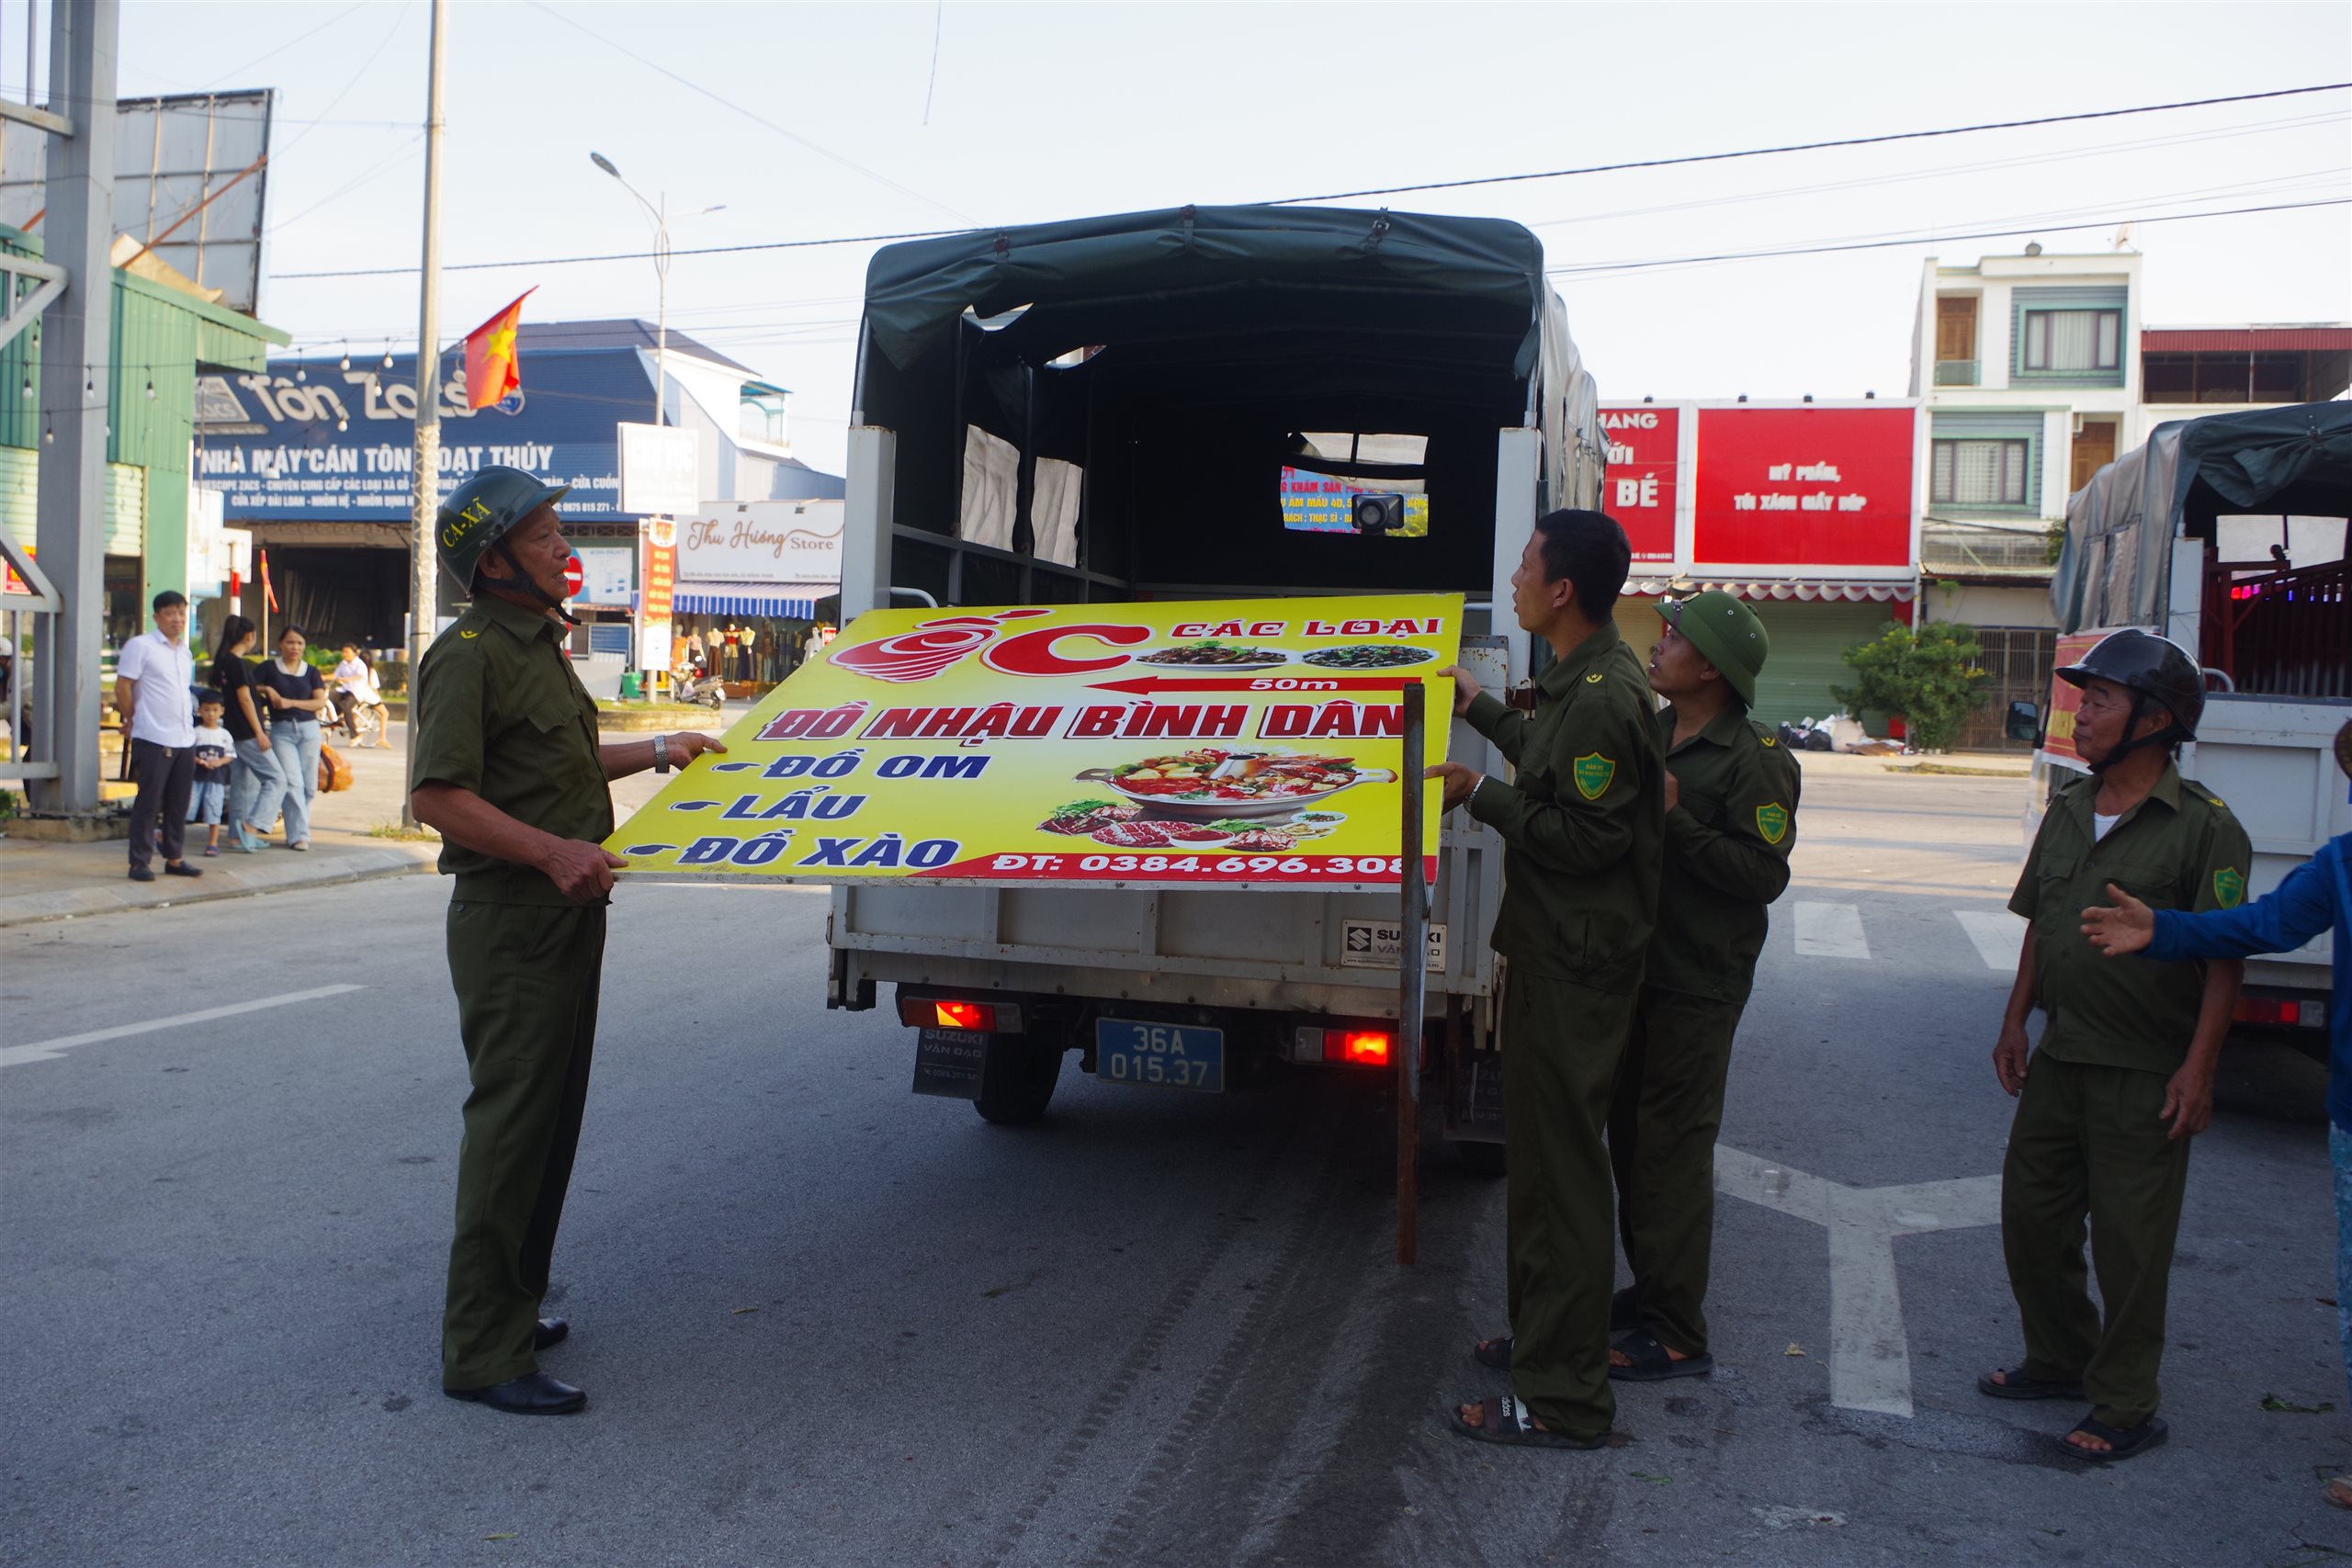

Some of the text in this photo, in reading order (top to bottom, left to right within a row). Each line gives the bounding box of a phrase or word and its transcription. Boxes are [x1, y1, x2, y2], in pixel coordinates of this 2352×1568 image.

[237, 374, 351, 423] Tôn
[1597, 412, 1659, 430] HANG
[201, 445, 246, 474] NHÀ
[252, 445, 302, 474] MÁY
[309, 445, 358, 473] CÁN
[364, 443, 412, 473] TÔN
[438, 446, 483, 476] OẠT
[1607, 441, 1634, 465] ỚI
[1615, 472, 1659, 508] BÉ
[687, 519, 725, 551] Thu
[790, 537, 834, 550] Store
[1170, 616, 1443, 639] CÁC LOẠI
[1249, 679, 1339, 691] 50m
[752, 699, 1404, 747] ĐỒ NHẬU BÌNH DÂN
[762, 748, 992, 780] ĐỒ OM
[721, 784, 867, 820] LẨU
[676, 828, 960, 868] ĐỒ XÀO
[992, 854, 1064, 872] ĐT:
[1376, 929, 1441, 943] SUKI
[924, 1029, 984, 1045] SUZUKI
[1133, 1026, 1185, 1055] 36A
[1111, 1053, 1208, 1087] 015.37
